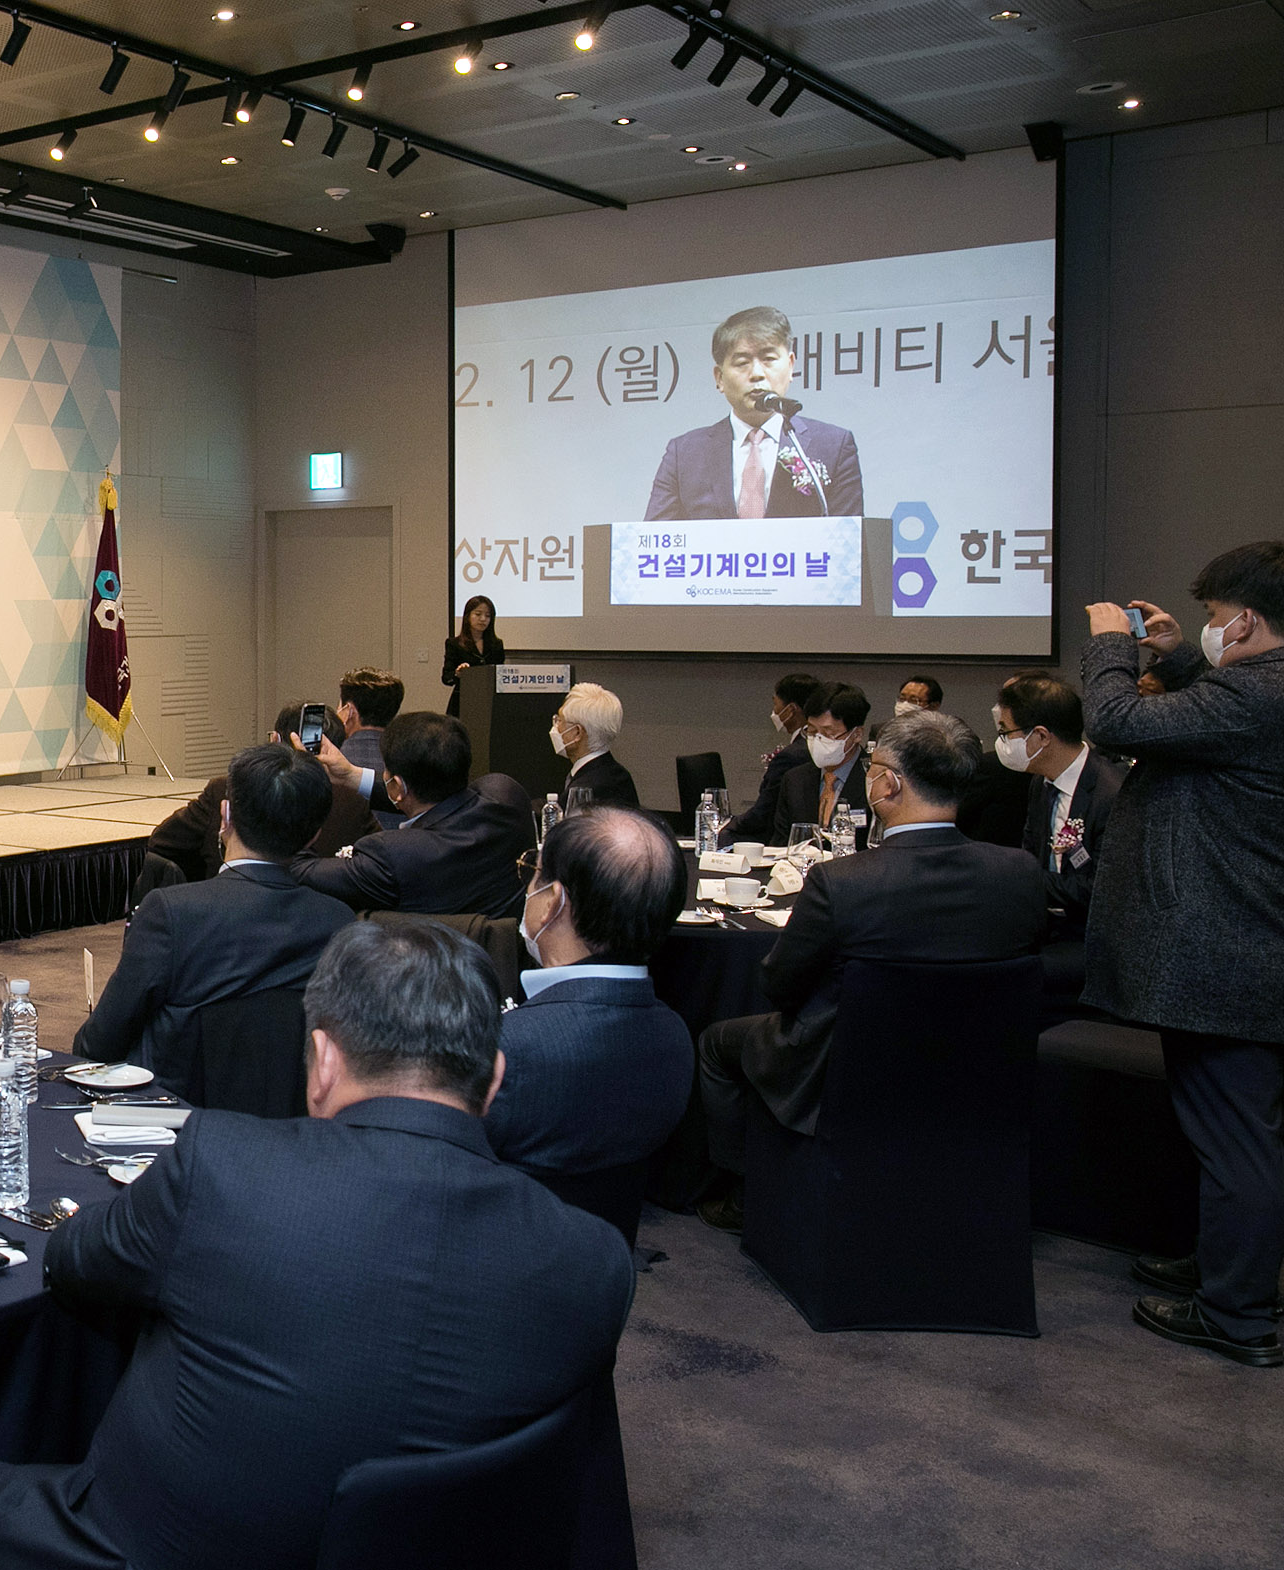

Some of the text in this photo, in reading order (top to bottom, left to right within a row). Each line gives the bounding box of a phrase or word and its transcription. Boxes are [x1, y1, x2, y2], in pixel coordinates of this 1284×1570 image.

[520, 354, 574, 403] 12
[596, 341, 680, 406] (월)
[972, 315, 1054, 379] 서
[455, 535, 584, 583] 상자원
[638, 533, 687, 549] 제18회
[960, 529, 1053, 584] 한국
[638, 551, 831, 578] 건설기계인의 날
[502, 674, 554, 684] 건설기계인의
